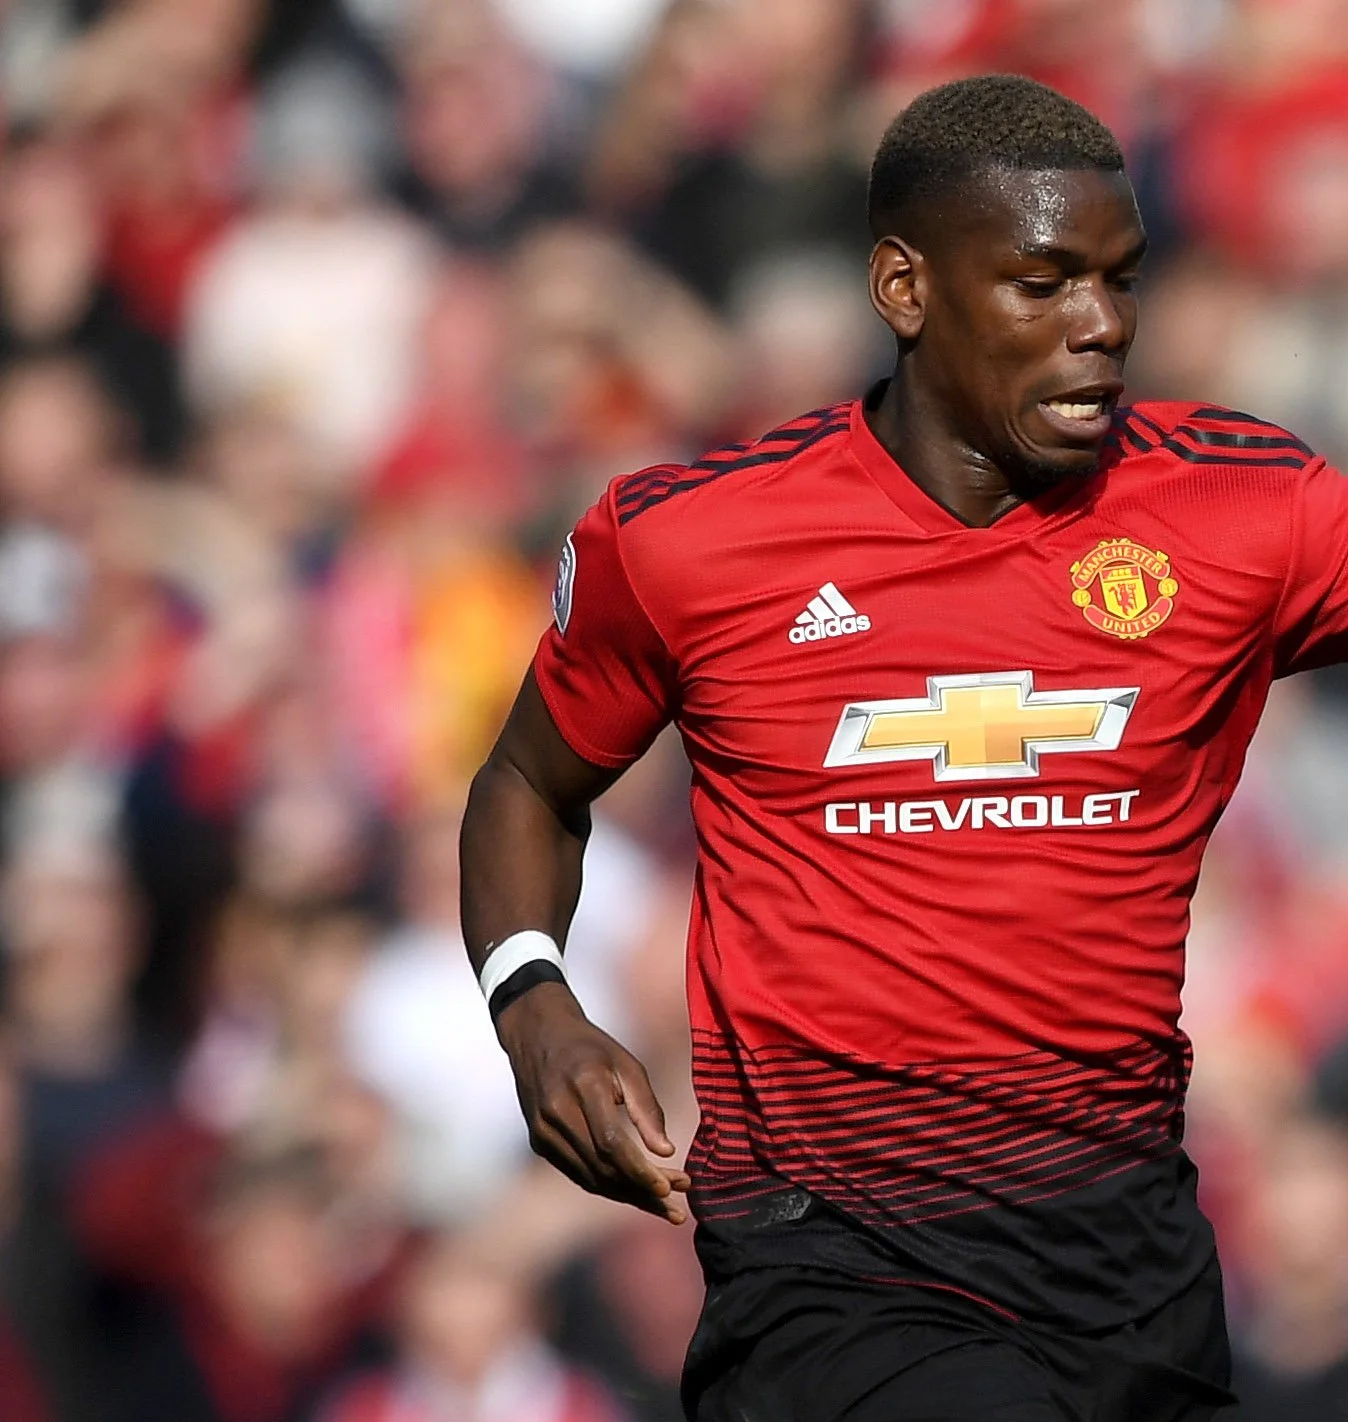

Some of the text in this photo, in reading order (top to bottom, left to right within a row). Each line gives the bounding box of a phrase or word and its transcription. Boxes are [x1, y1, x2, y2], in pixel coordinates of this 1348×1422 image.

[1078, 547, 1163, 582] MANCHESTER
[788, 614, 872, 644] adidas
[1102, 611, 1161, 633] UNITED
[825, 789, 1141, 834] CHEVROLET
